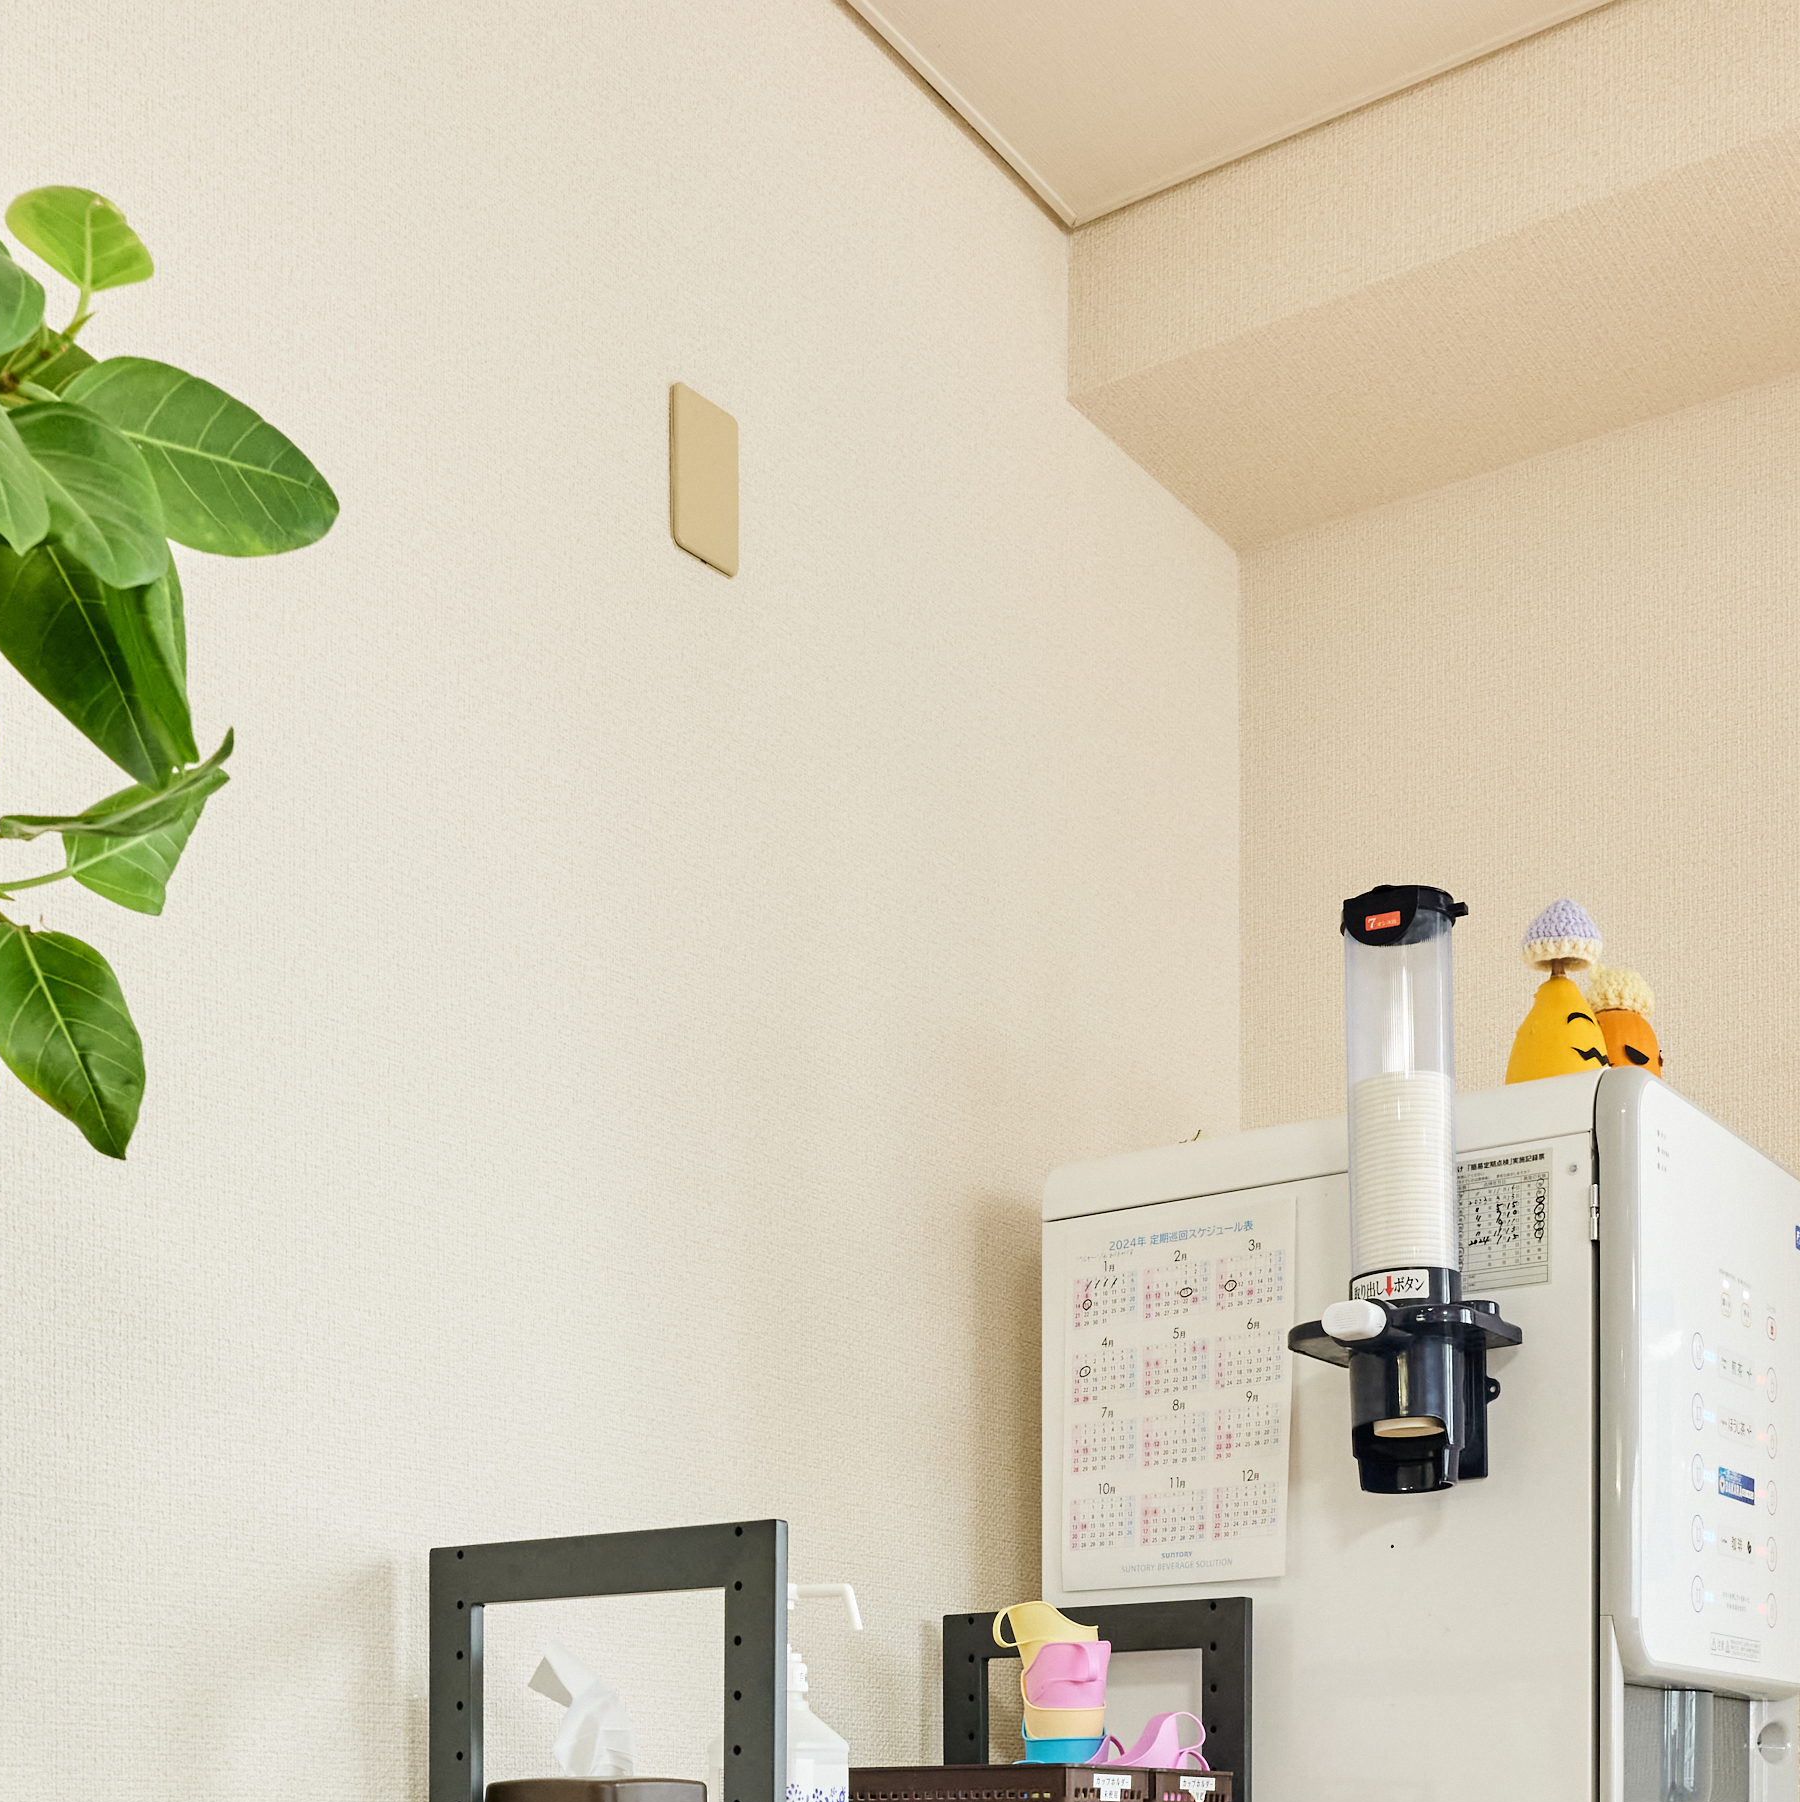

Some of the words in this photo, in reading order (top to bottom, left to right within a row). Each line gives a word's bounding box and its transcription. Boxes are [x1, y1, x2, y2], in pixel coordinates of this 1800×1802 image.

[1368, 918, 1377, 928] 7
[1109, 1236, 1146, 1250] 2024年
[1150, 1220, 1254, 1246] 定期巡回スケジュール表
[1248, 1239, 1262, 1252] 3月
[1174, 1250, 1187, 1262] 2月
[1104, 1260, 1115, 1272] 1月
[1394, 1276, 1425, 1293] ボタン
[1246, 1318, 1260, 1330] 6月
[1172, 1327, 1186, 1340] 5月
[1102, 1336, 1114, 1348] 4月
[1246, 1390, 1259, 1402] 9月
[1102, 1406, 1114, 1418] 7月
[1172, 1399, 1186, 1412] 8月
[1242, 1469, 1260, 1482] 12月
[1098, 1482, 1116, 1495] 10月
[1170, 1476, 1186, 1489] 11月
[1162, 1550, 1194, 1559] SUNTORY
[1122, 1564, 1156, 1573] SUNTORY
[1196, 1558, 1233, 1568] SOLUTION
